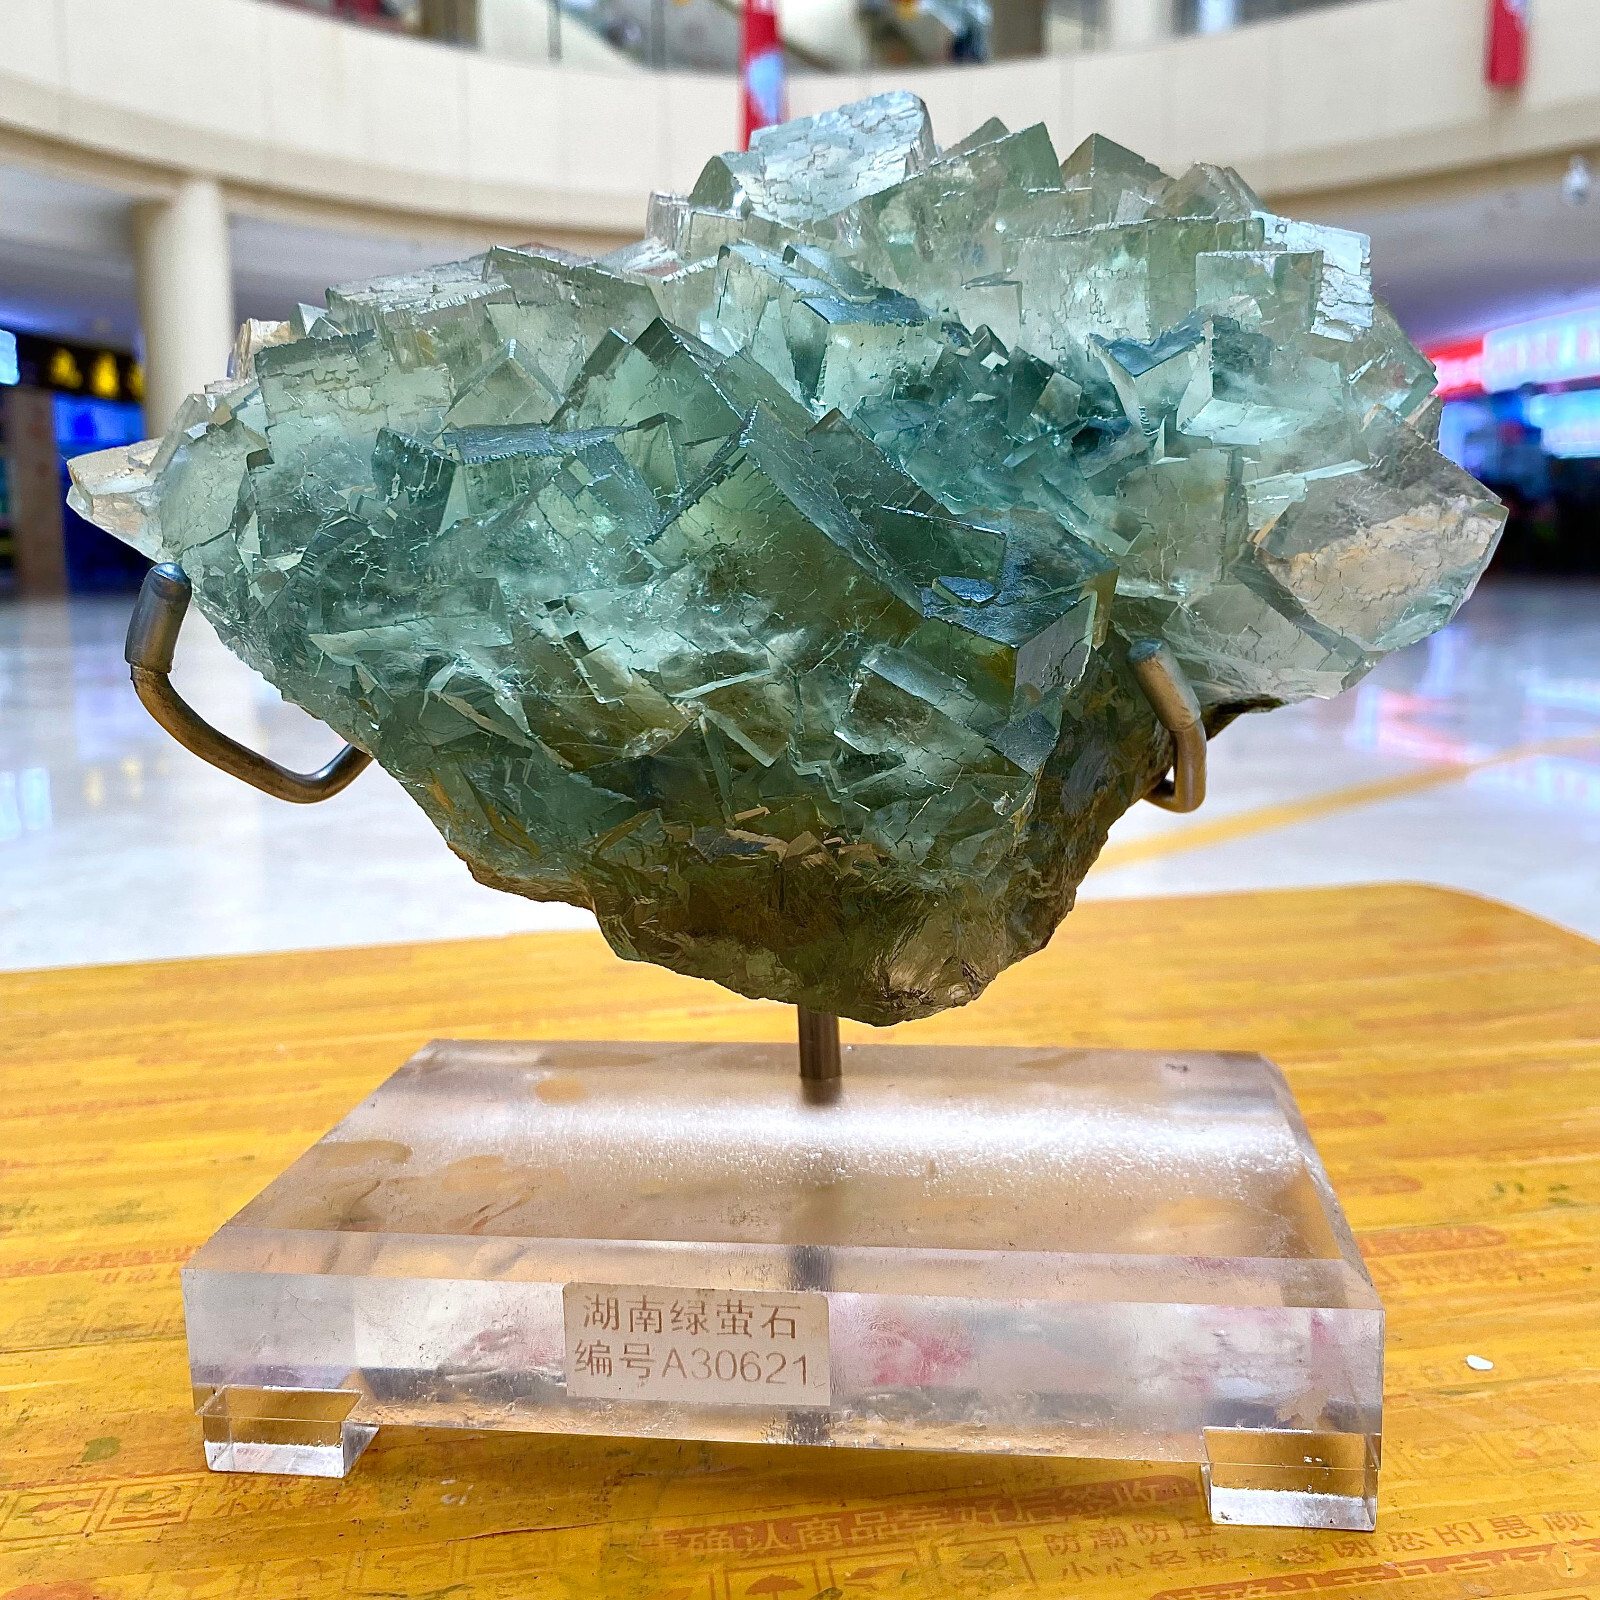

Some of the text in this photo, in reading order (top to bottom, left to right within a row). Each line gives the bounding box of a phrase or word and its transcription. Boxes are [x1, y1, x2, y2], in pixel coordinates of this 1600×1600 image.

[583, 1294, 801, 1339] 湖南绿萤石
[574, 1339, 808, 1386] 编号A30621
